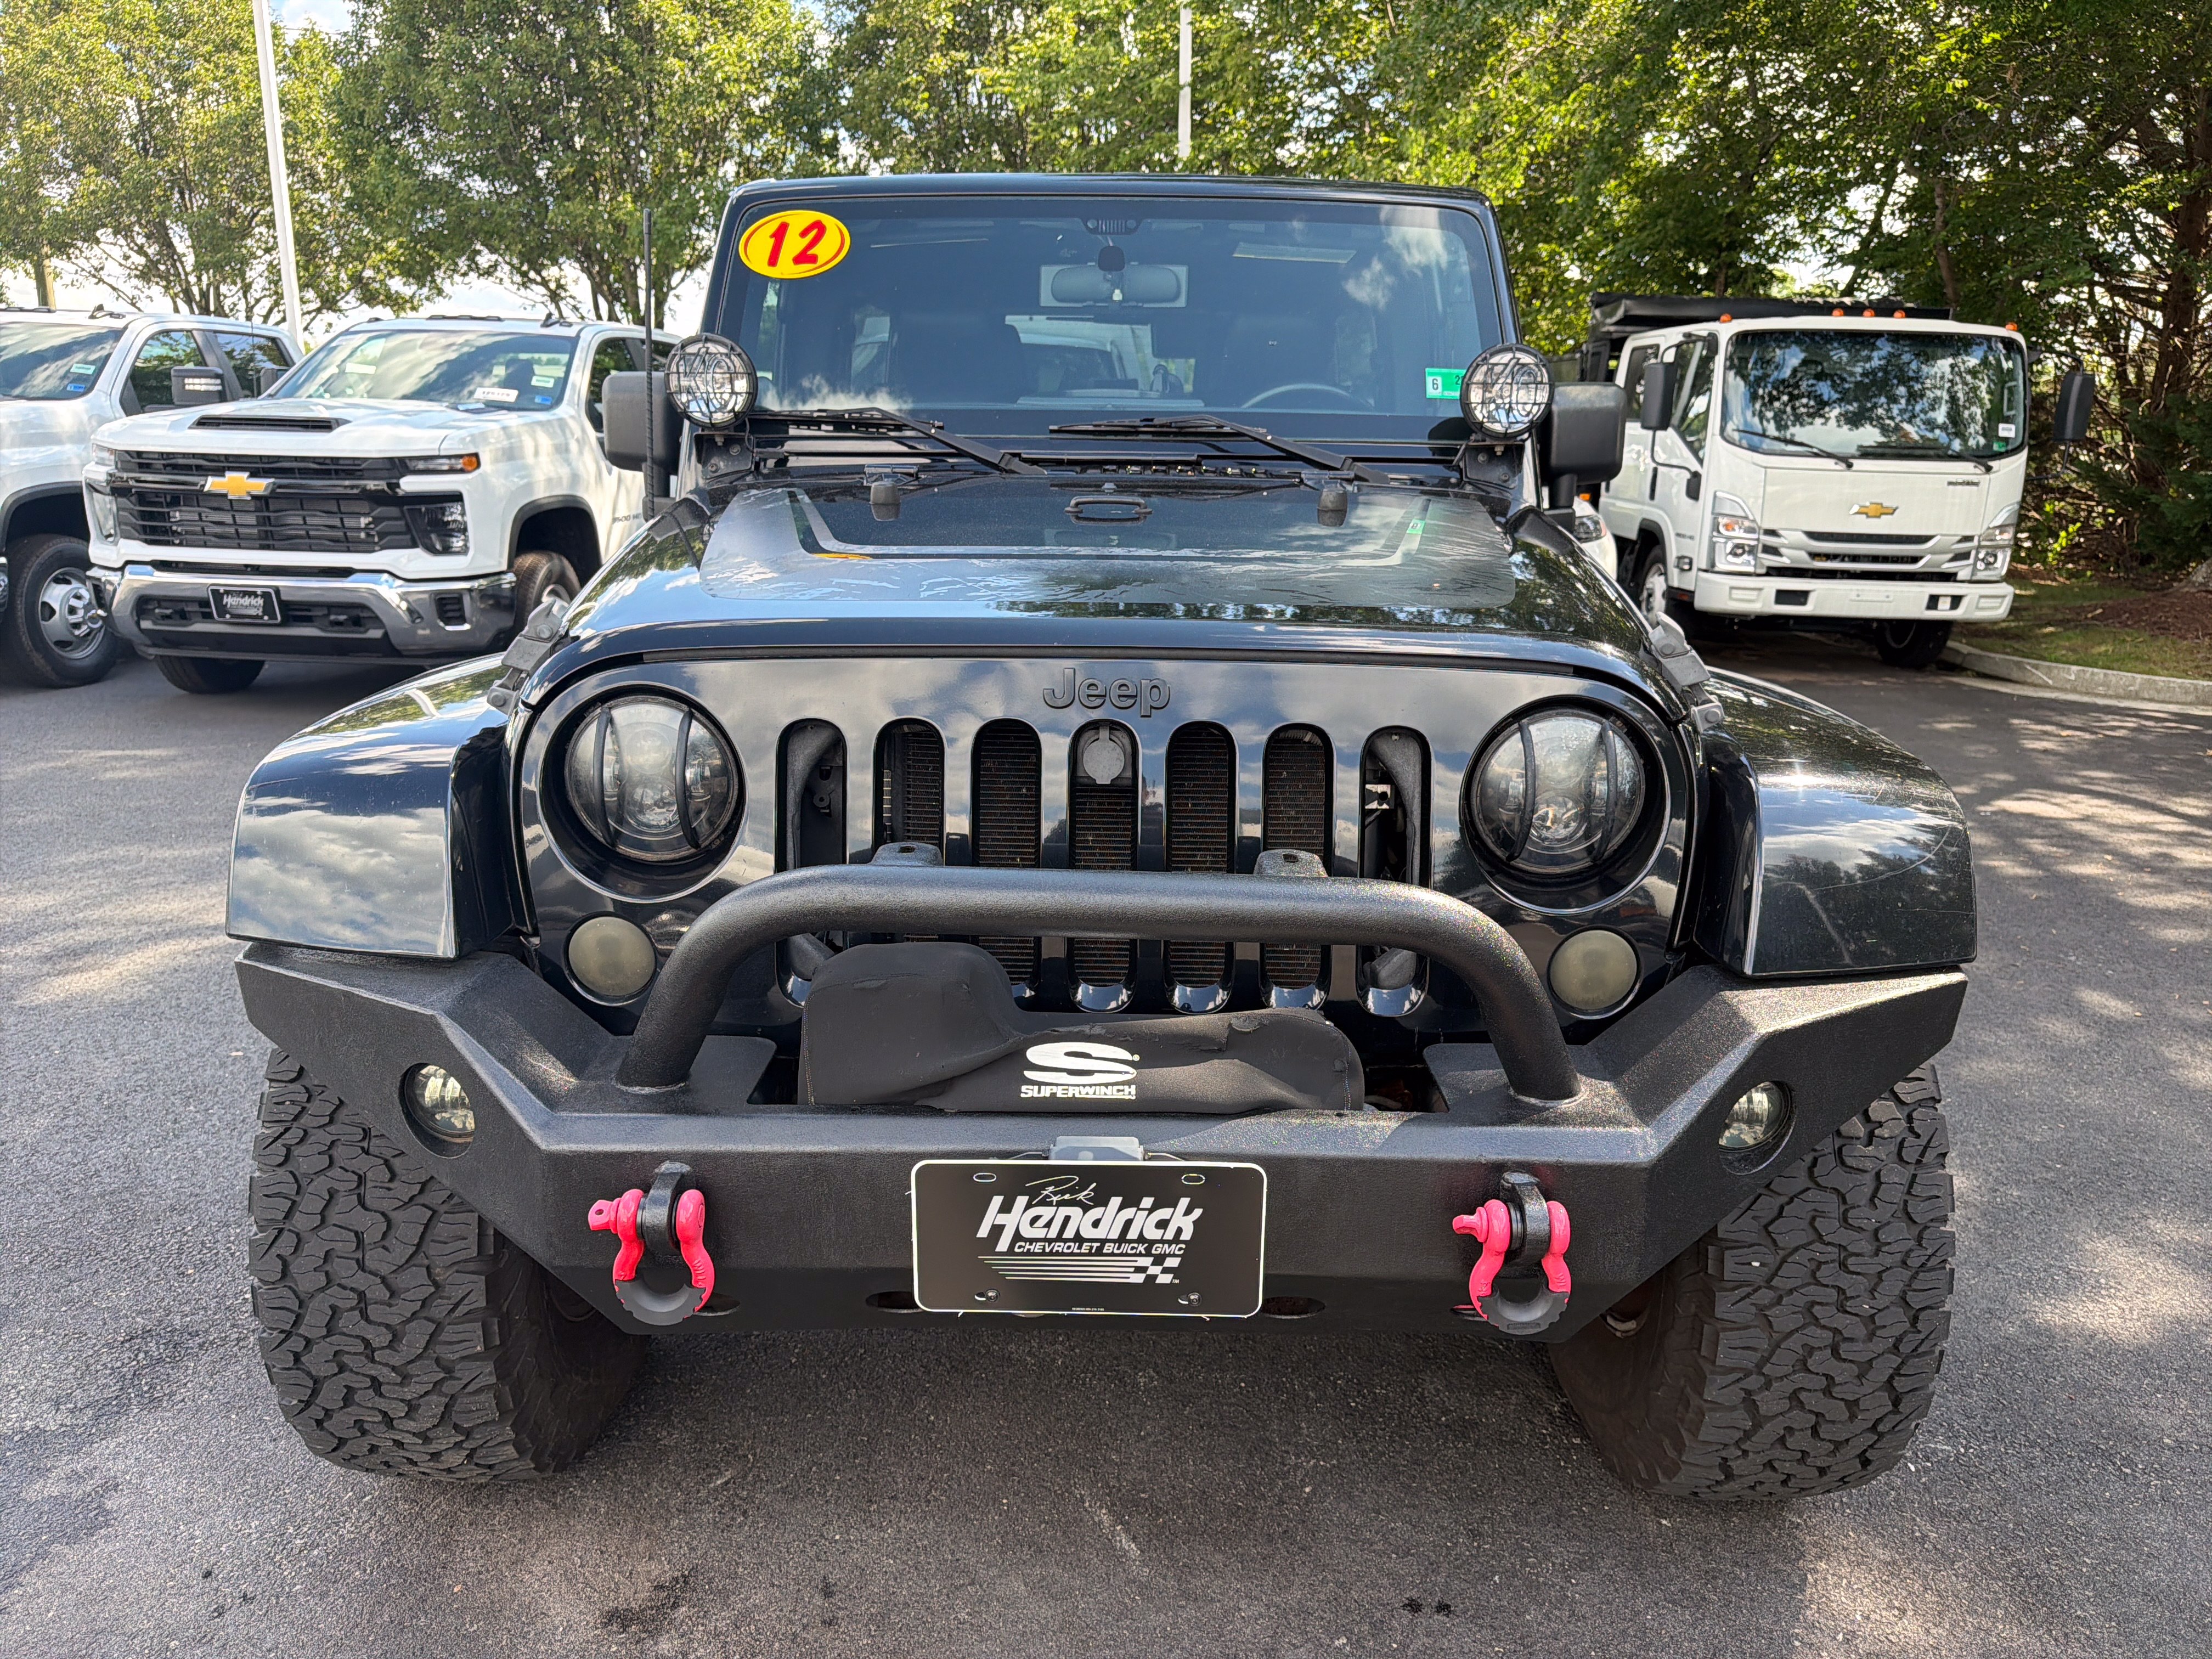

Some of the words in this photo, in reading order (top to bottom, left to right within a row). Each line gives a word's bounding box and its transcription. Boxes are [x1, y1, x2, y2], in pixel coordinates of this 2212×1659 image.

[768, 220, 827, 267] 12
[1432, 378, 1438, 391] 6
[1043, 667, 1170, 718] Jeep
[1020, 1085, 1136, 1099] SUPERWINCH
[976, 1195, 1203, 1252] Hendrick
[1014, 1242, 1101, 1253] CHEVROLET
[1103, 1243, 1148, 1254] BUICK
[1152, 1244, 1186, 1254] GMC
